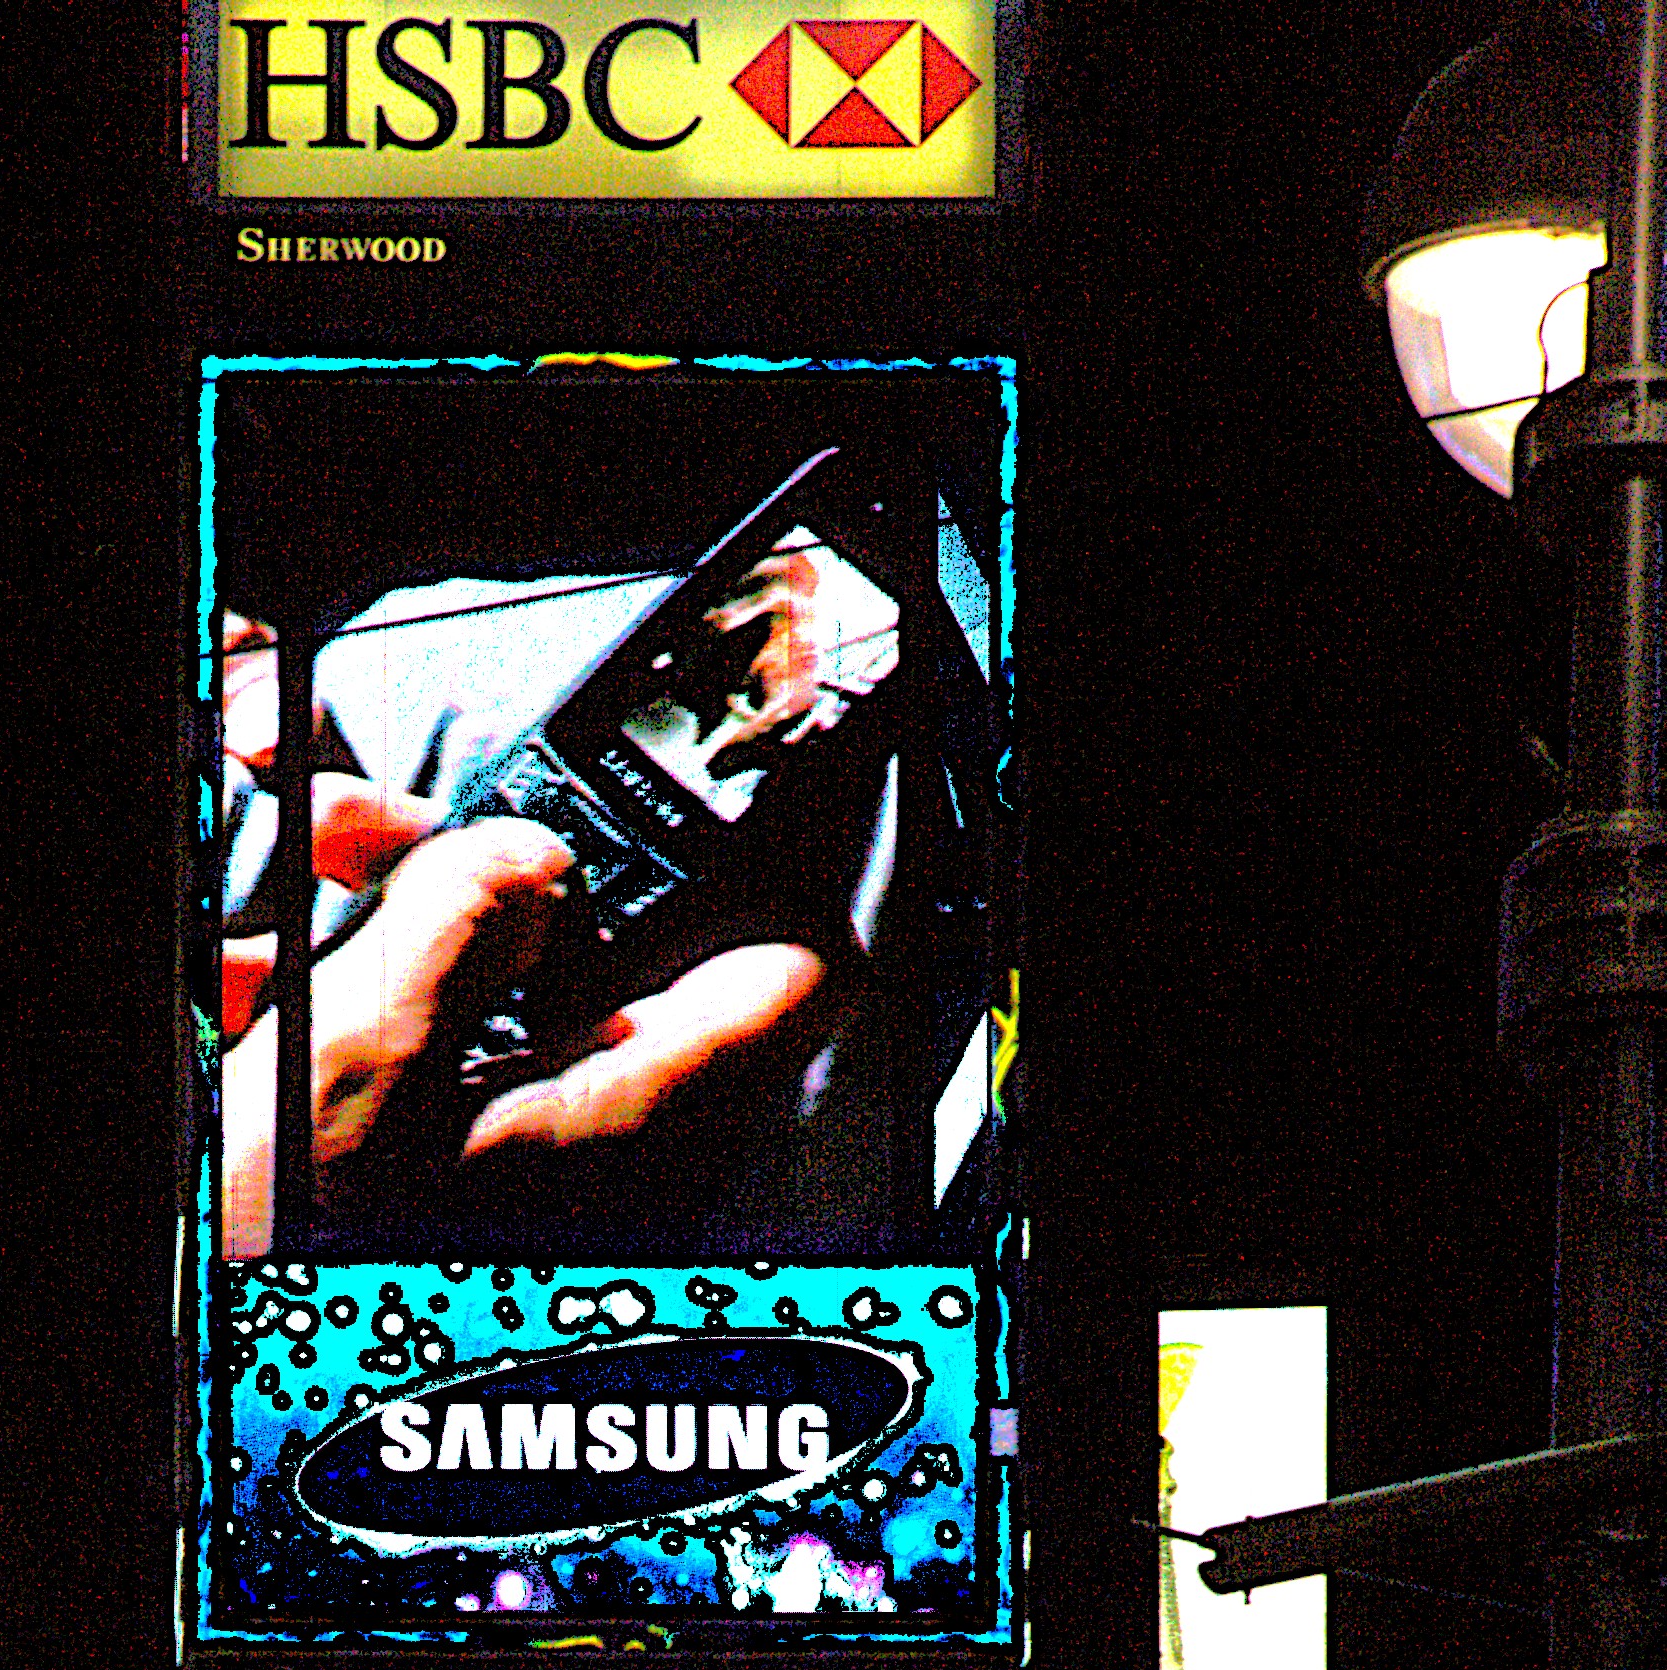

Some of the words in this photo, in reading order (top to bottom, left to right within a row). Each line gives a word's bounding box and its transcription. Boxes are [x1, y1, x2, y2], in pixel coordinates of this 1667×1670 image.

[229, 16, 704, 152] HSBC
[235, 226, 447, 263] SHERWOOD
[379, 1403, 831, 1472] SAMSUNG
